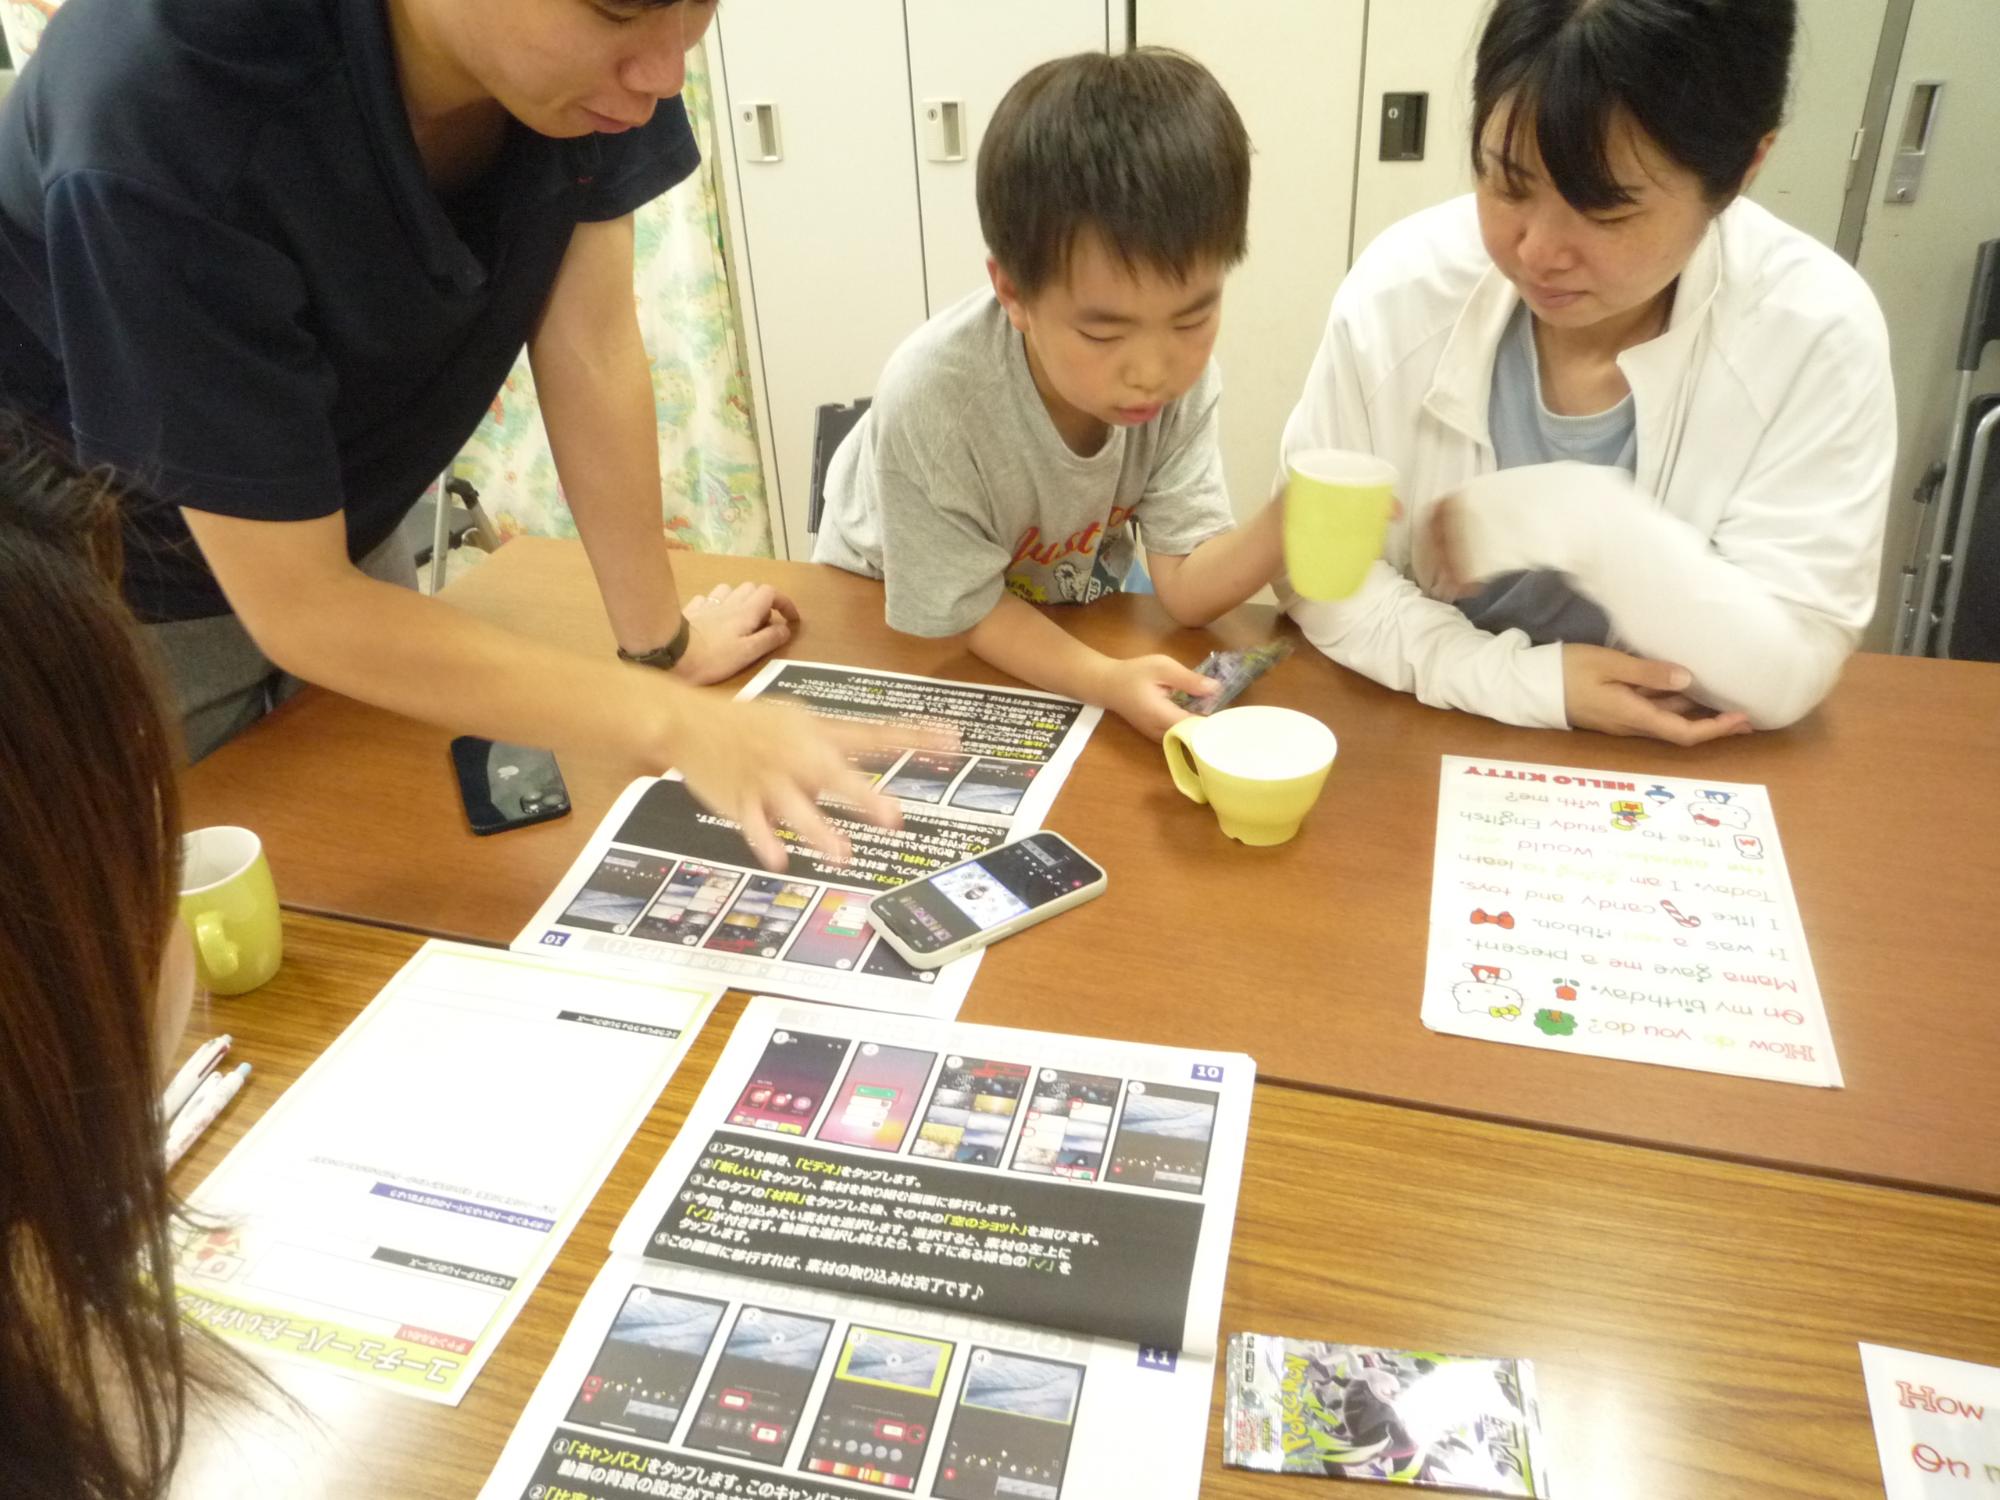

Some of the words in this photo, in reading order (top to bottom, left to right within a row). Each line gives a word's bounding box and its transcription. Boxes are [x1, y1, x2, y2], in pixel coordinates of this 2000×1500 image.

[1463, 765, 1547, 783] KITTY
[1552, 774, 1636, 791] HELLO
[1460, 811, 1540, 829] English
[1609, 958, 1642, 971] me
[1654, 963, 1712, 983] gave
[1722, 972, 1798, 993] Mama
[1643, 1025, 1692, 1040] you
[1749, 1040, 1816, 1062] How
[1197, 1066, 1220, 1079] 10
[1144, 1347, 1170, 1366] 11
[1895, 1380, 1984, 1420] How
[1912, 1443, 1970, 1479] On
